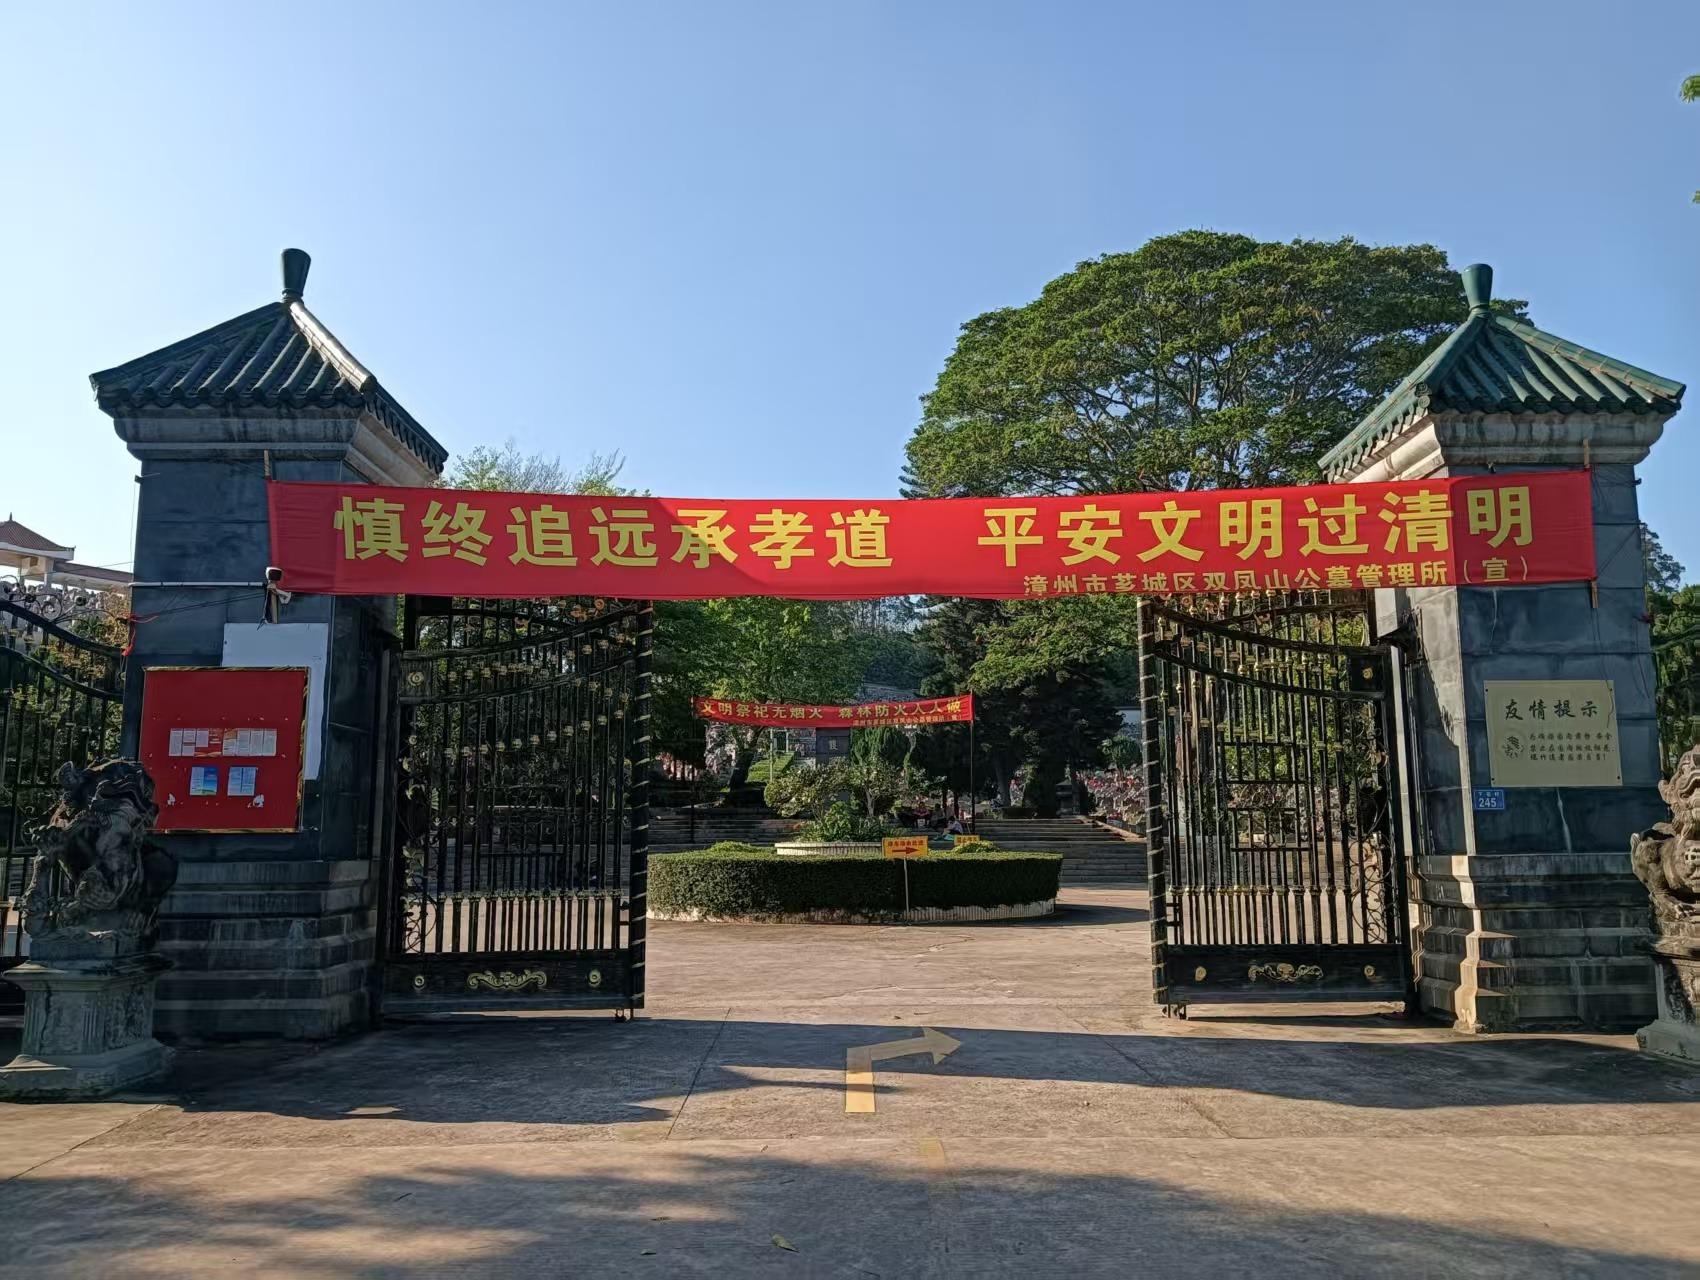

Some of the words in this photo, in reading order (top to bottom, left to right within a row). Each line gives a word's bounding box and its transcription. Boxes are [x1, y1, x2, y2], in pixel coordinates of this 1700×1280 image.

[334, 496, 893, 570] 慎终追远承孝道
[977, 485, 1534, 568] 平安文明过清明
[700, 700, 823, 720] 文明祭祀无烟火
[1504, 698, 1598, 721] 友情提示
[1478, 797, 1497, 808] 245
